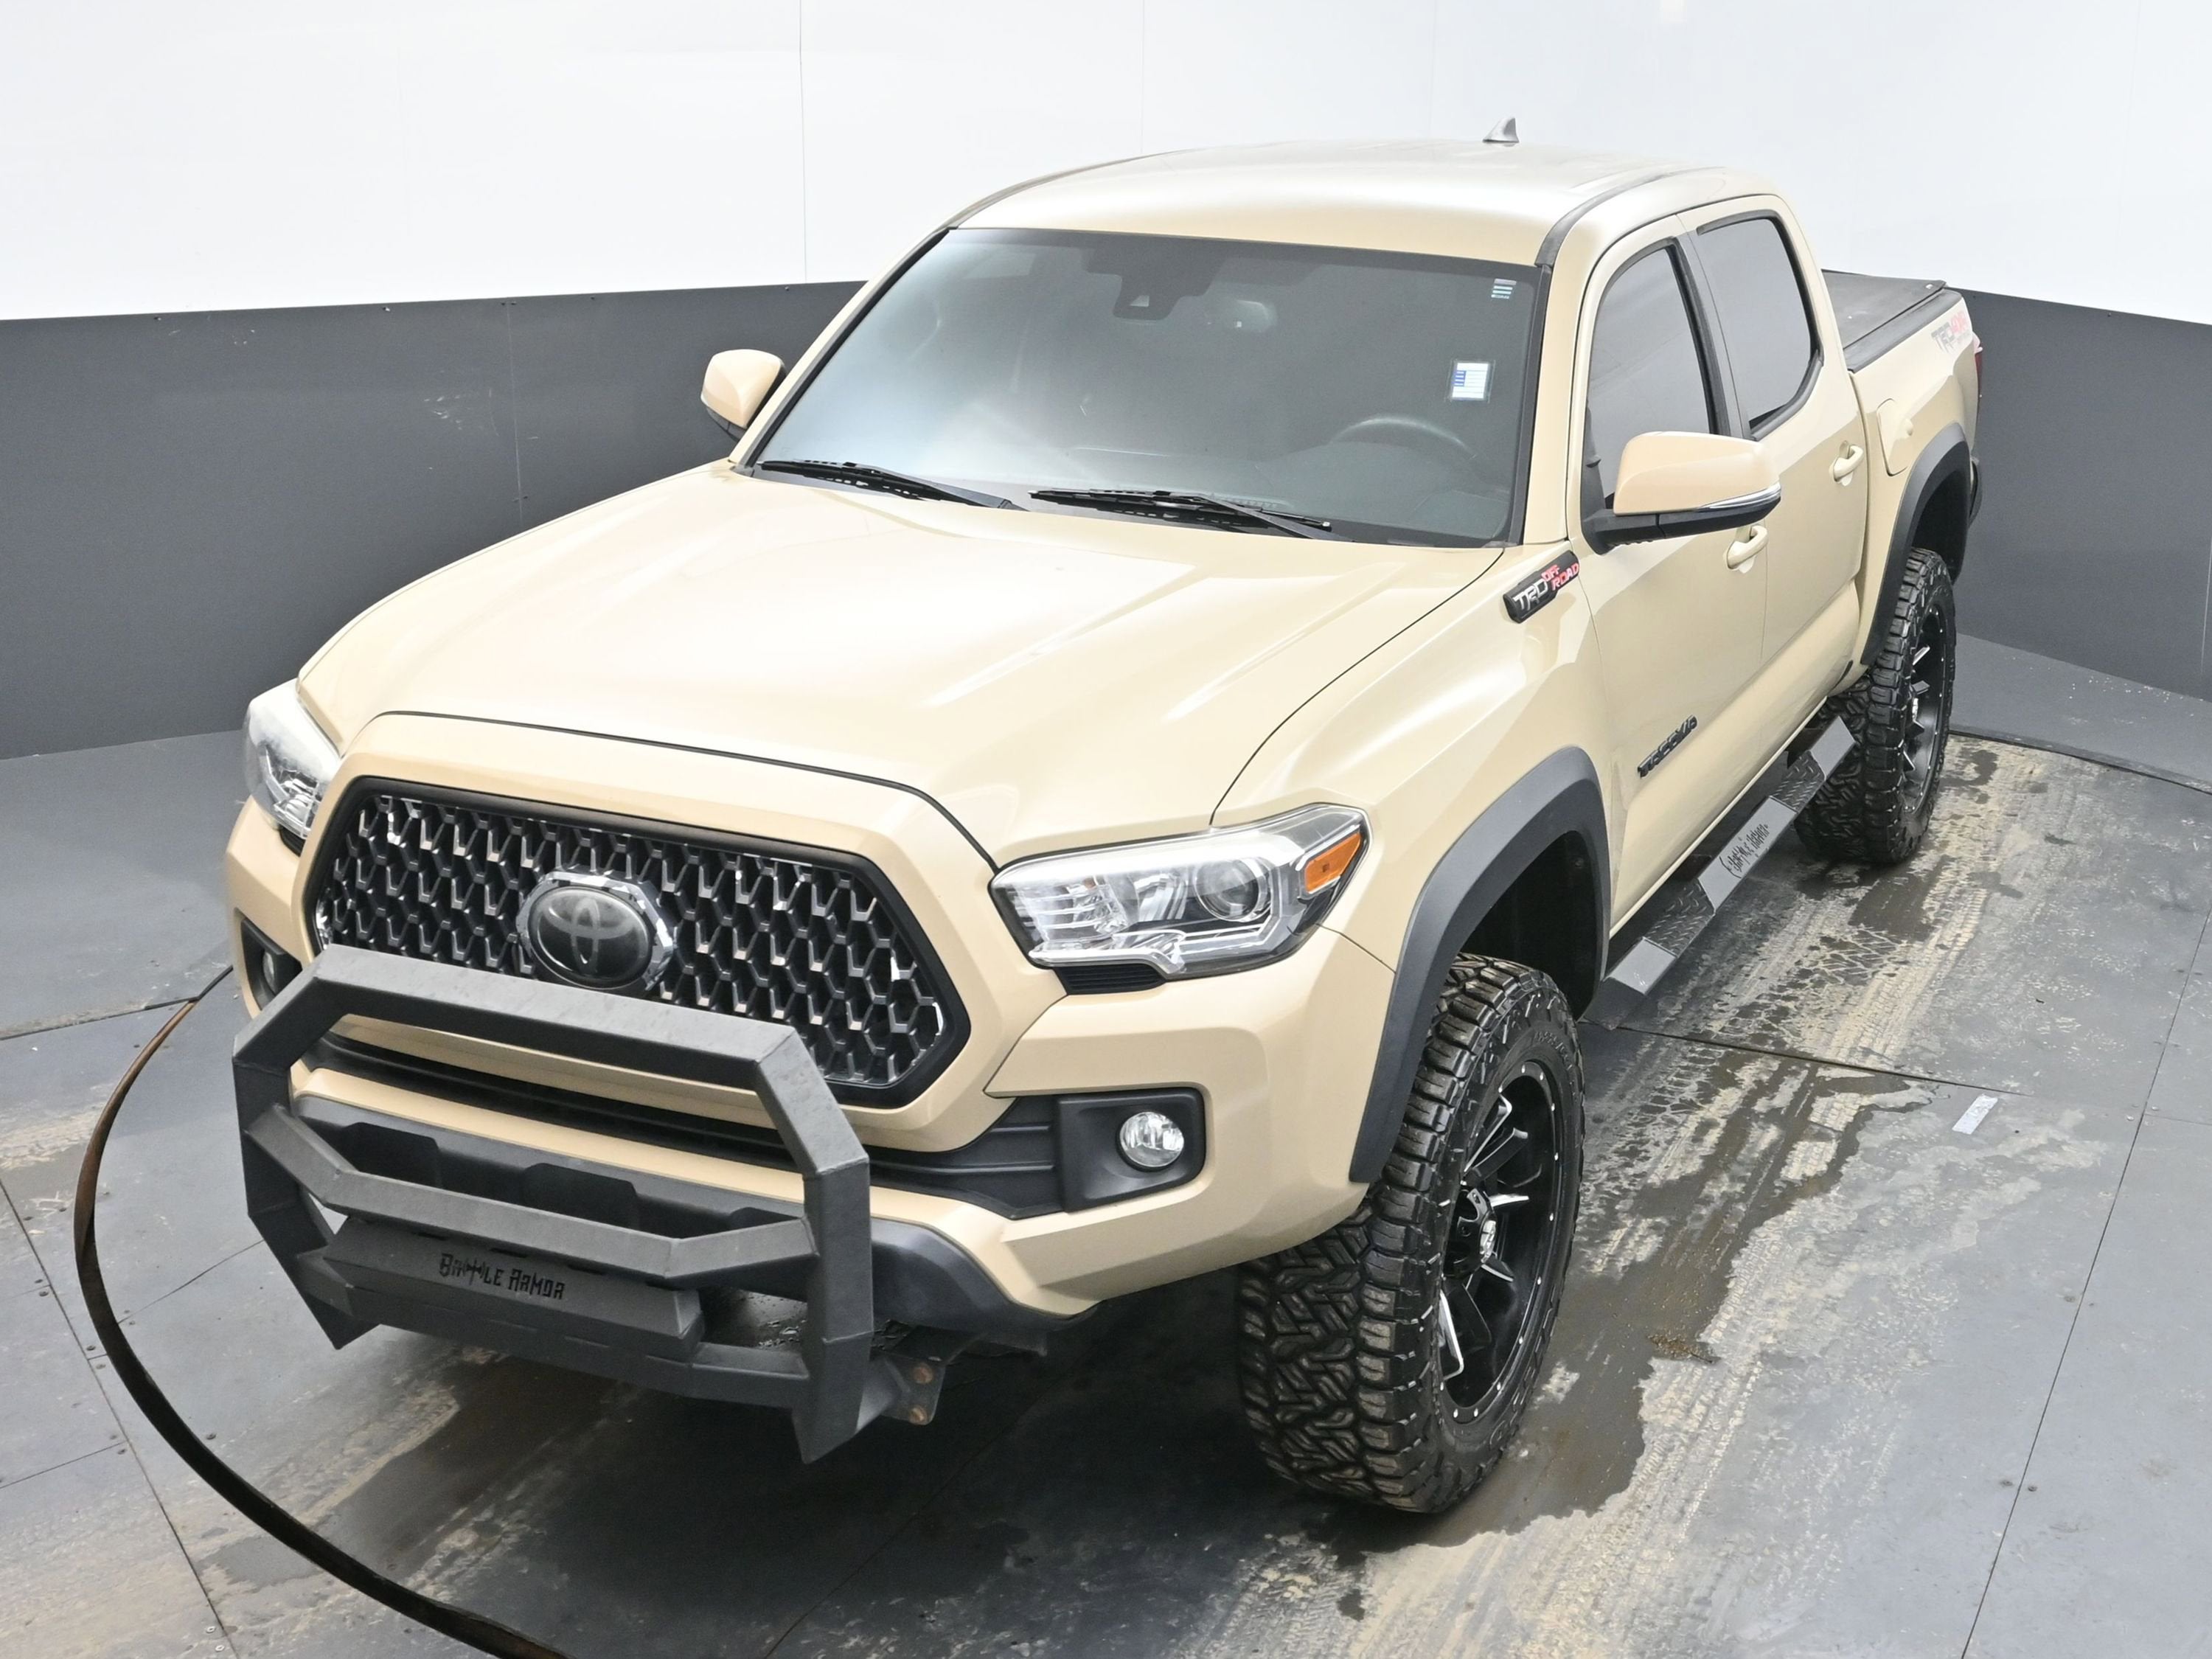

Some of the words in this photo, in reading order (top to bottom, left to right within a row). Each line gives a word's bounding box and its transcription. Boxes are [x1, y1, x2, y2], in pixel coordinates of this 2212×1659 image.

[1541, 564, 1560, 582] OFF
[1550, 563, 1579, 591] ROAD
[1512, 577, 1548, 611] TRD
[1637, 714, 1697, 779] TACOMA
[508, 1268, 566, 1300] ARMOR
